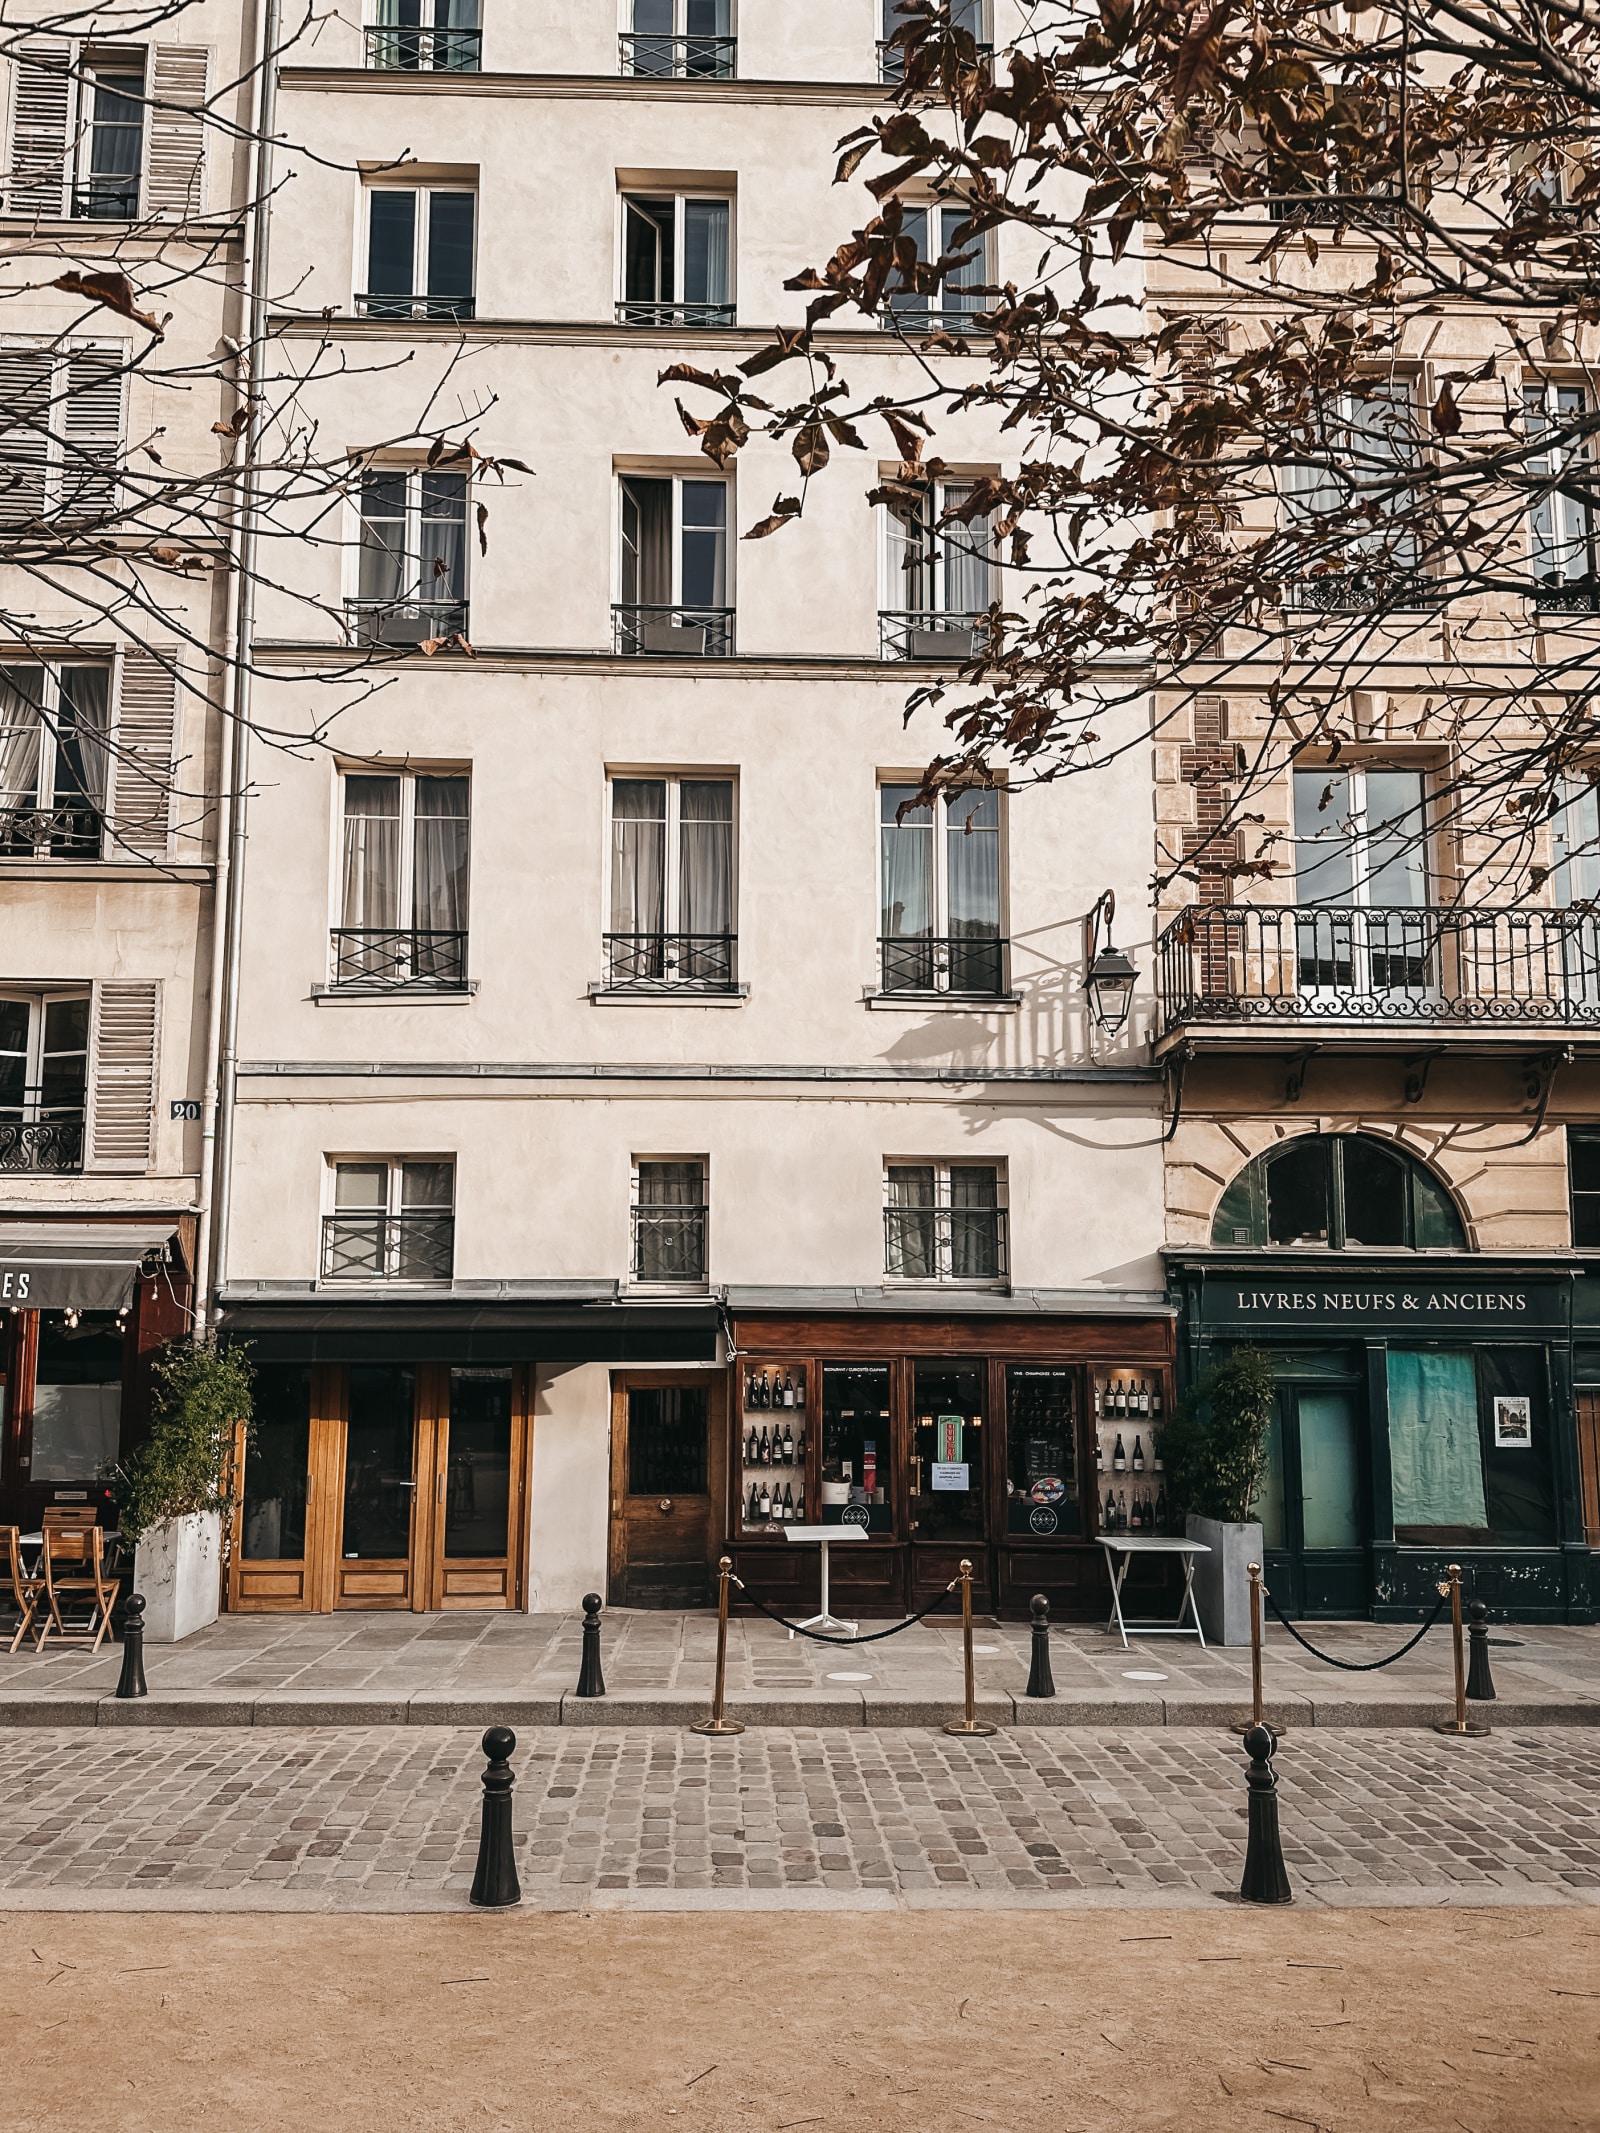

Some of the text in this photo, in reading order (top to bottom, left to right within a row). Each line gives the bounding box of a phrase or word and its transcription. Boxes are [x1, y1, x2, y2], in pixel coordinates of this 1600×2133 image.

[173, 1103, 197, 1120] 20
[2, 1272, 30, 1299] ES
[1237, 1292, 1527, 1311] LIVRES NEUFS & ANCIENS
